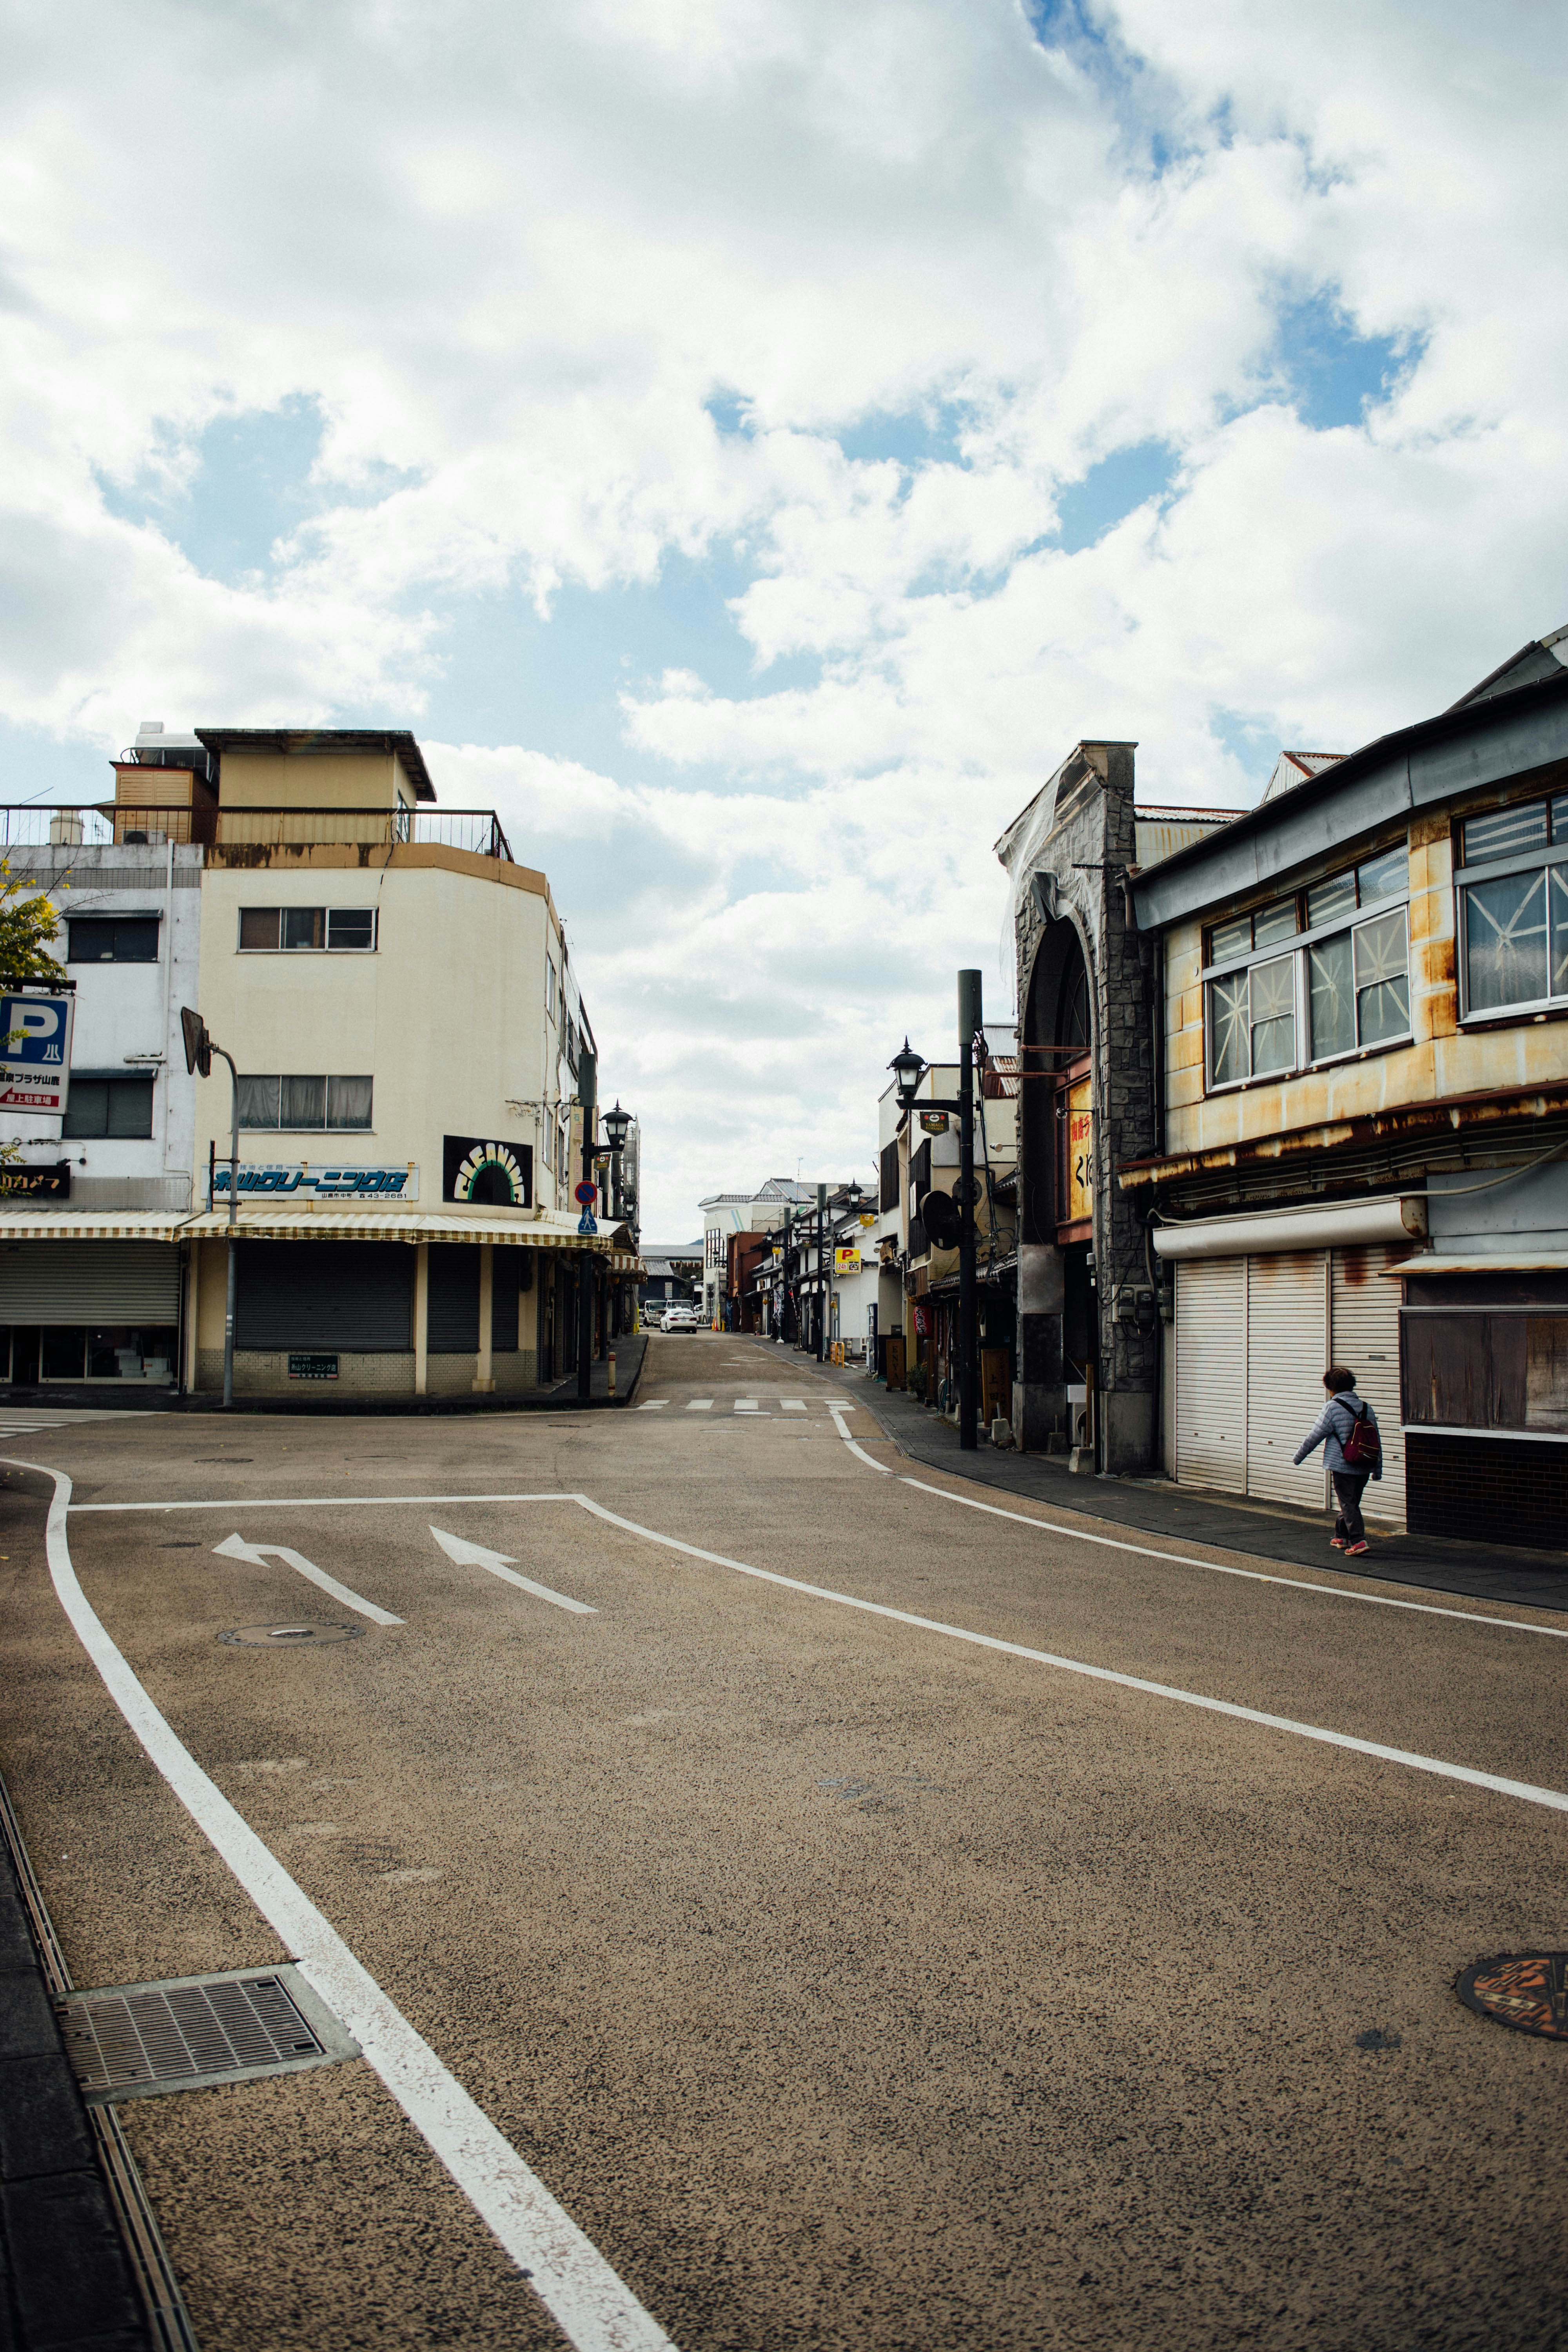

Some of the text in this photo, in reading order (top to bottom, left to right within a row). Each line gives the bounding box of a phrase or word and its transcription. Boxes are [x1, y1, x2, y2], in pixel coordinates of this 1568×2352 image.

[8, 1003, 58, 1054] P
[6, 1094, 51, 1105] 屋上駐車場
[1072, 1114, 1092, 1142] 山鹿ラ
[213, 1171, 408, 1192] 糸山クリーニング店
[454, 1142, 524, 1205] CLEANING
[842, 1249, 853, 1260] P
